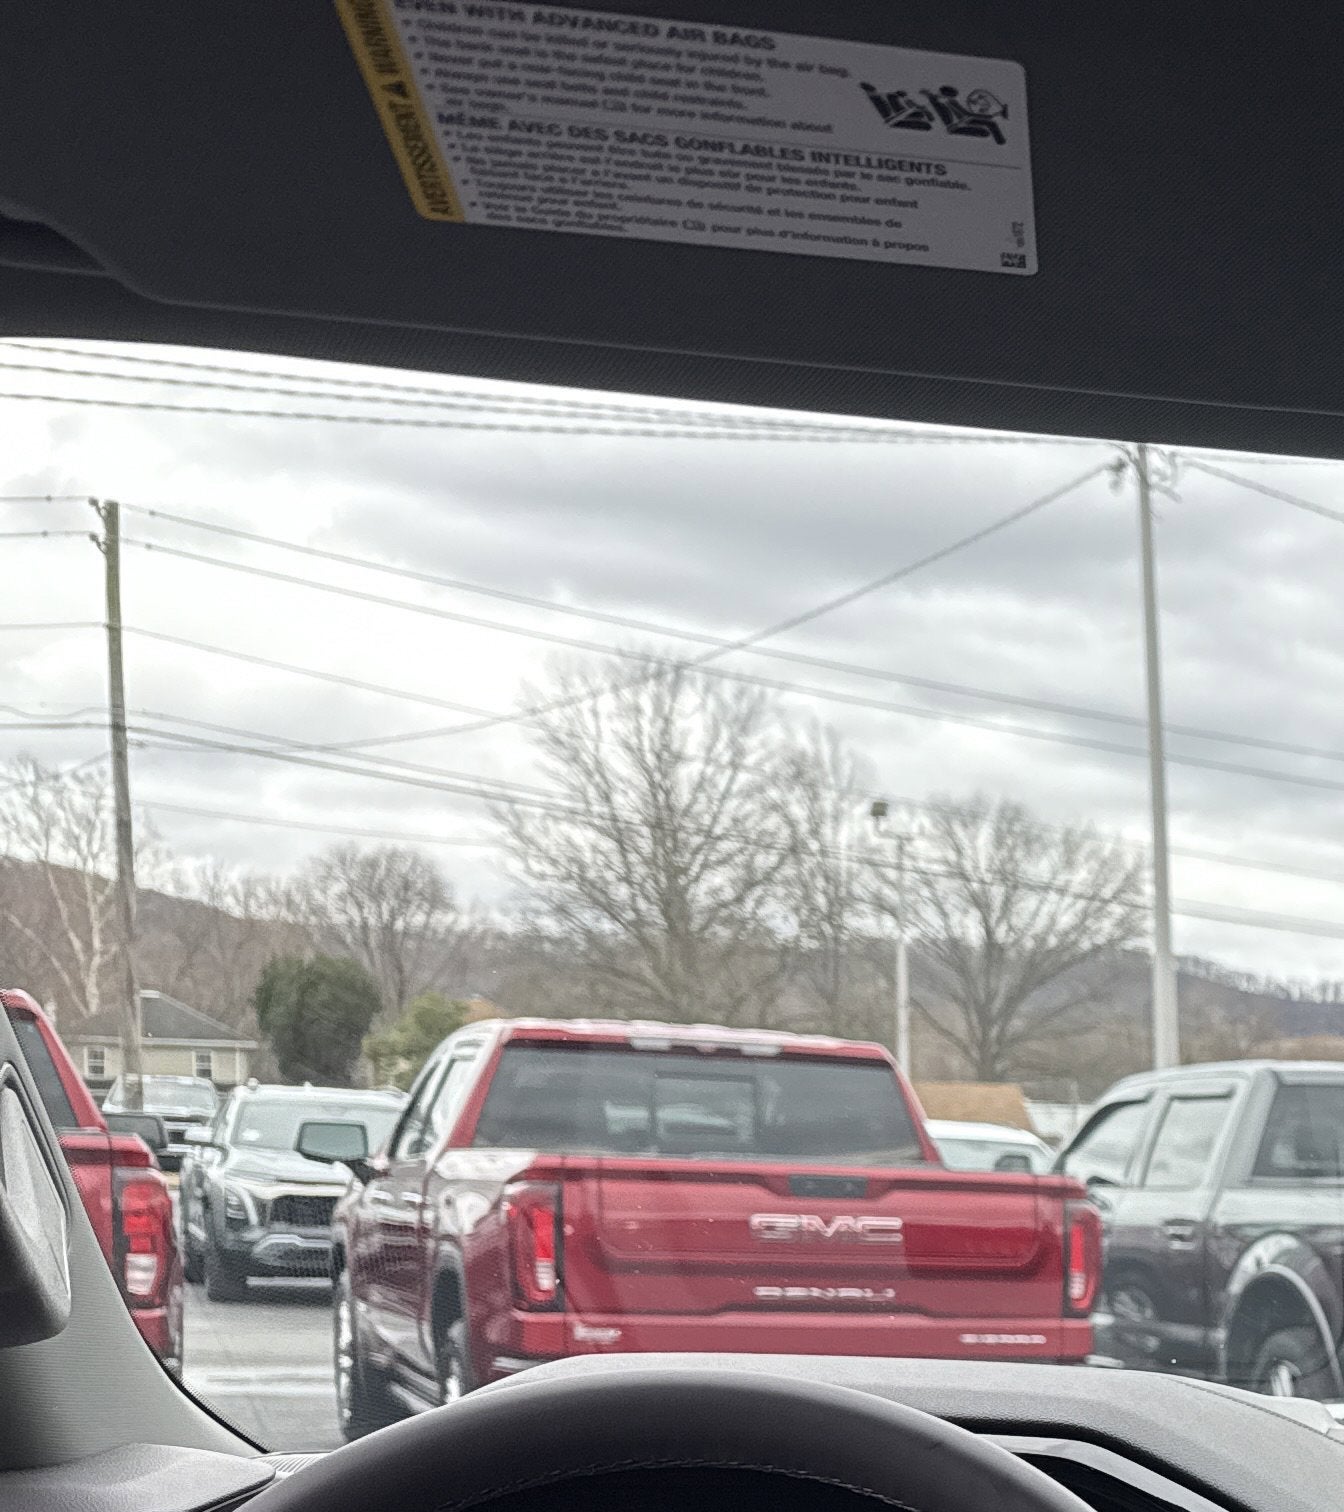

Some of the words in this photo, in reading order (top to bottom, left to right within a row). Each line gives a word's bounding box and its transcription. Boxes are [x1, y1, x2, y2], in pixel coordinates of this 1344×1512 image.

[532, 10, 660, 38] ADVANCED
[667, 26, 706, 42] AIR
[712, 30, 776, 50] BAGS
[567, 124, 609, 141] DES
[613, 129, 668, 147] SACS
[674, 135, 805, 162] GONFLABLES
[810, 149, 947, 177] INTELLIGENTS
[749, 1213, 904, 1244] GMC
